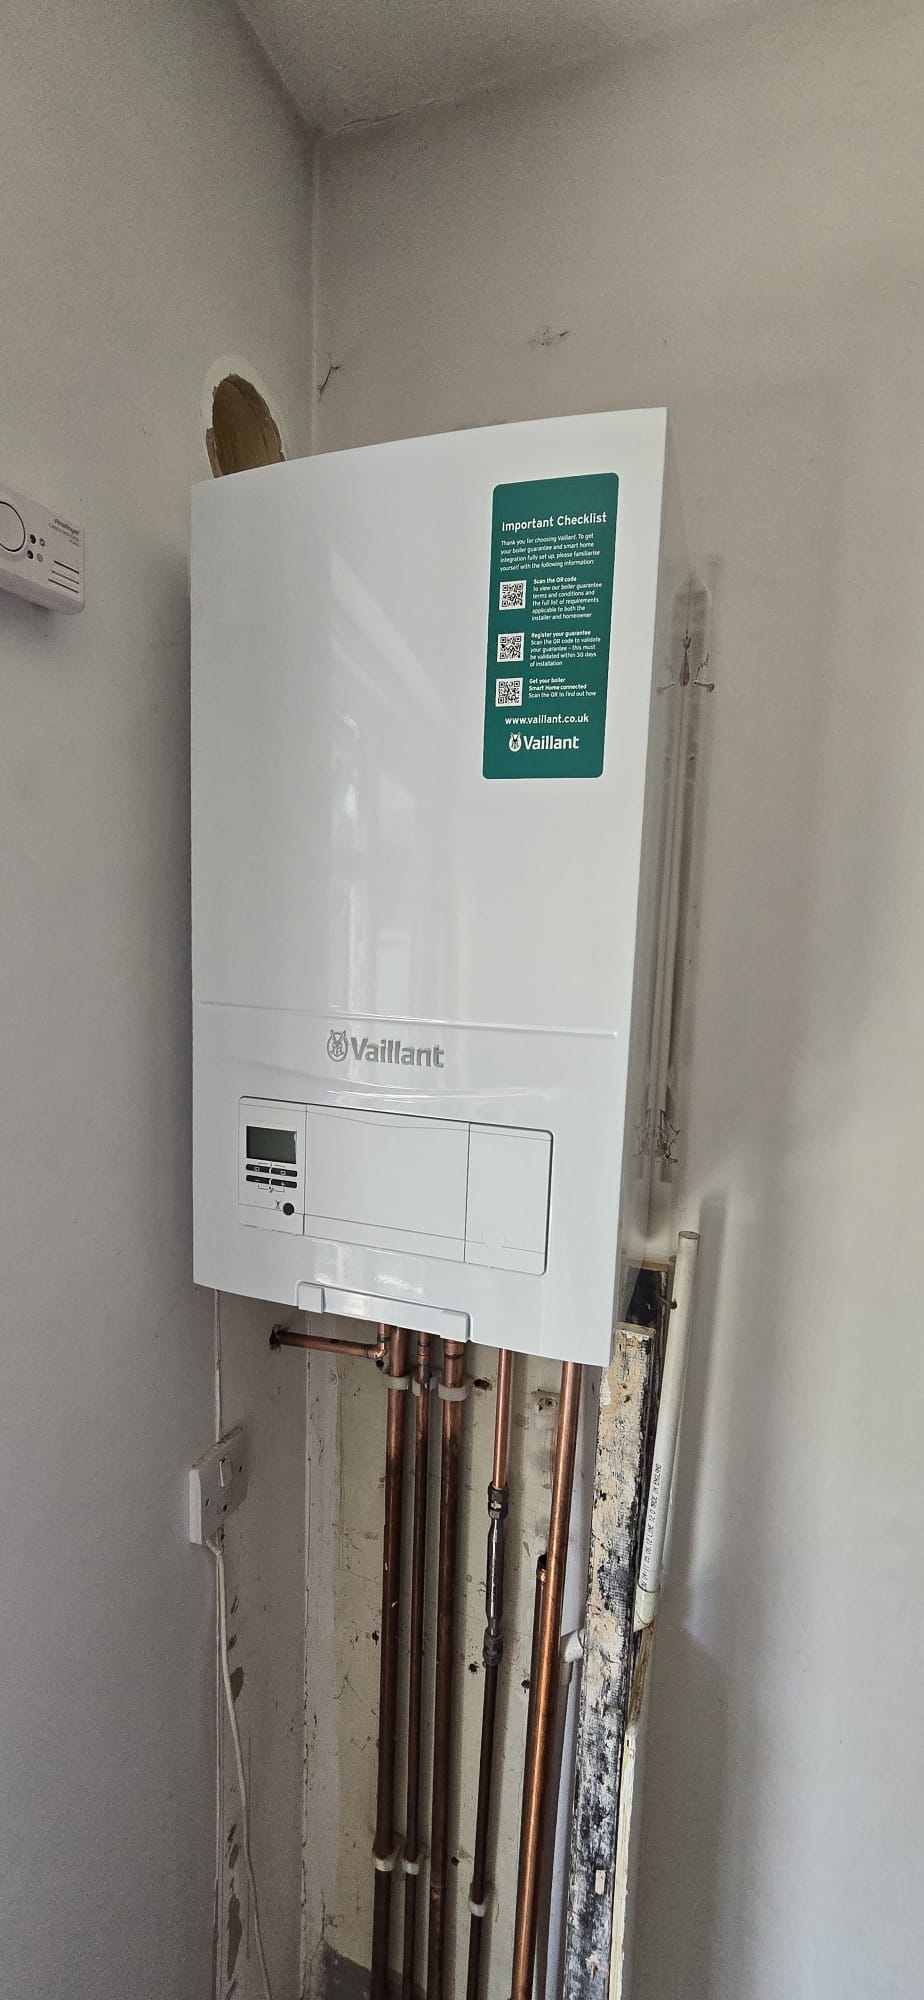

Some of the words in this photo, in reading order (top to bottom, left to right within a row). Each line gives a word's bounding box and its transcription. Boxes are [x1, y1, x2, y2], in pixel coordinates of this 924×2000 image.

[502, 516, 553, 532] Important
[557, 512, 607, 526] Checklist
[527, 545, 551, 553] guarantee
[500, 564, 519, 572] yourself
[576, 582, 602, 590] guarantee
[565, 630, 591, 638] guarantee
[505, 713, 589, 725] www.vaillant.co.uk
[523, 735, 579, 750] Vaillant
[351, 1037, 444, 1068] Vaillant
